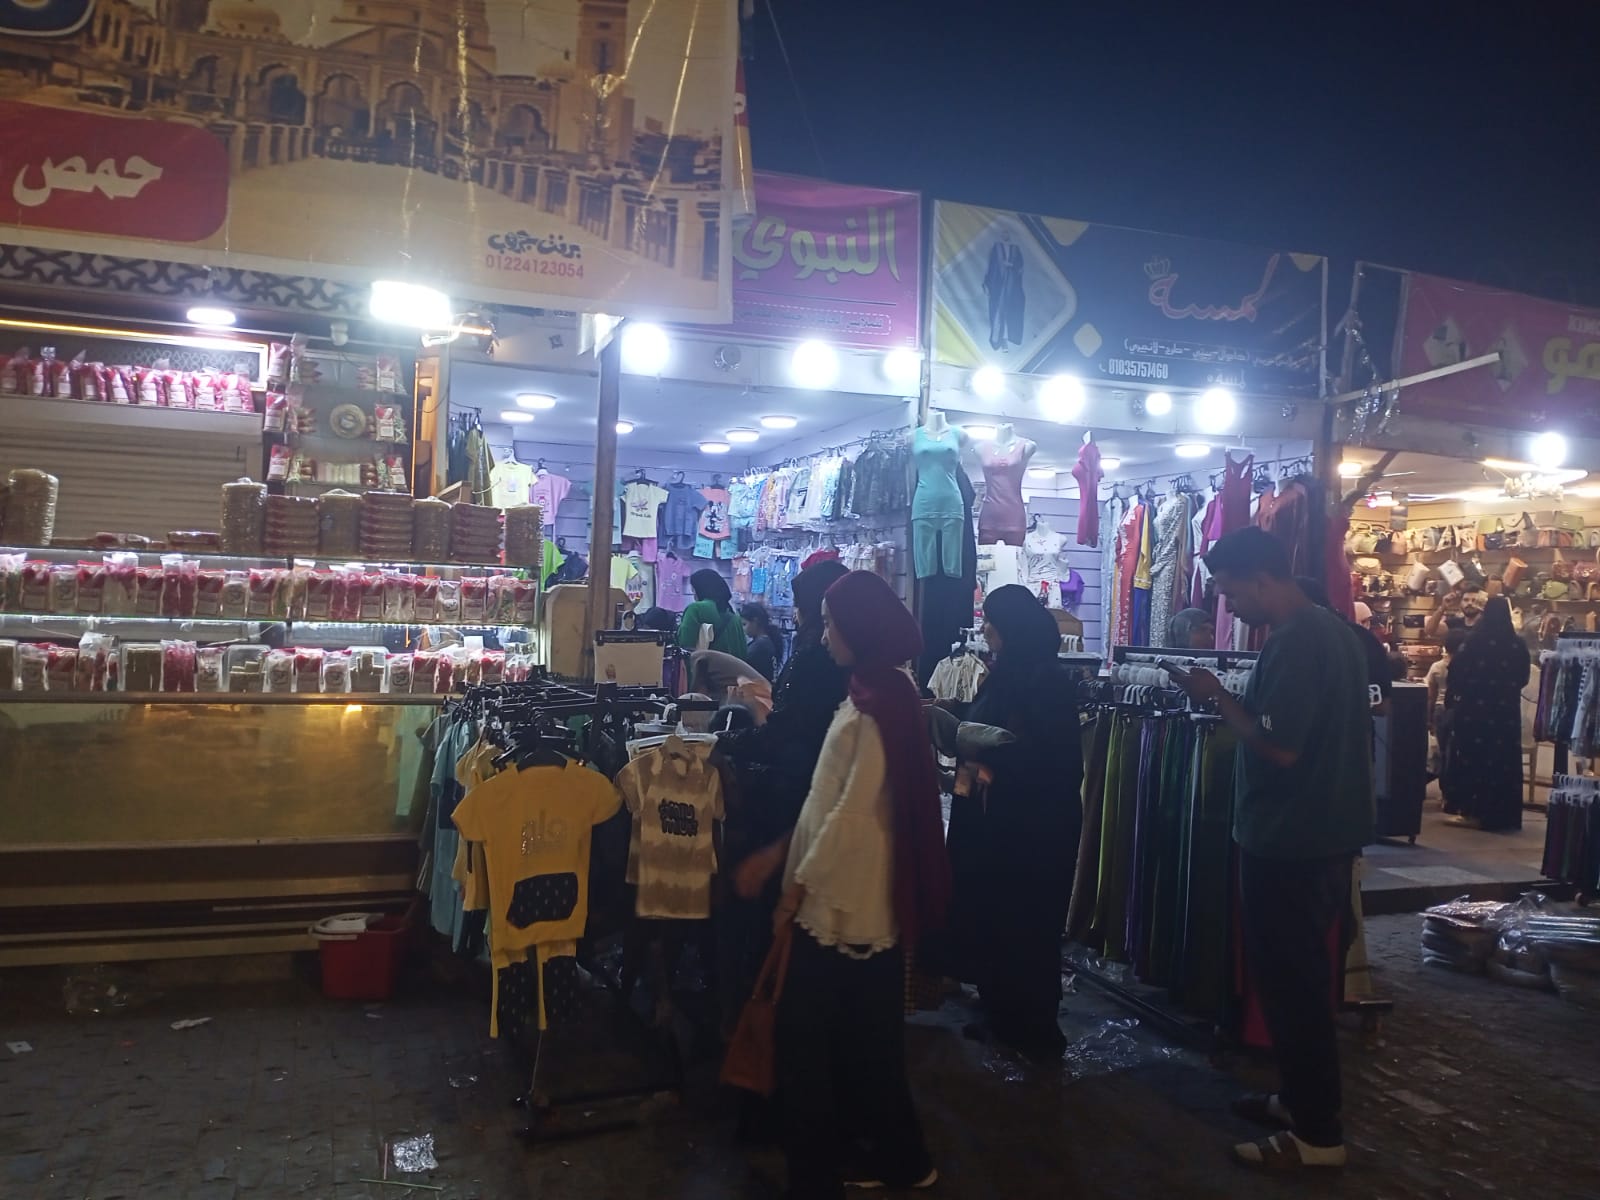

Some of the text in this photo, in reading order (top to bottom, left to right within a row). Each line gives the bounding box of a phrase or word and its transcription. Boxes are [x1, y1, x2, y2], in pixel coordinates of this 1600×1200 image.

[12, 154, 164, 208] حمص
[732, 206, 900, 285] النبوي
[485, 253, 584, 278] 01224123054
[1108, 358, 1169, 380] 01035757460
